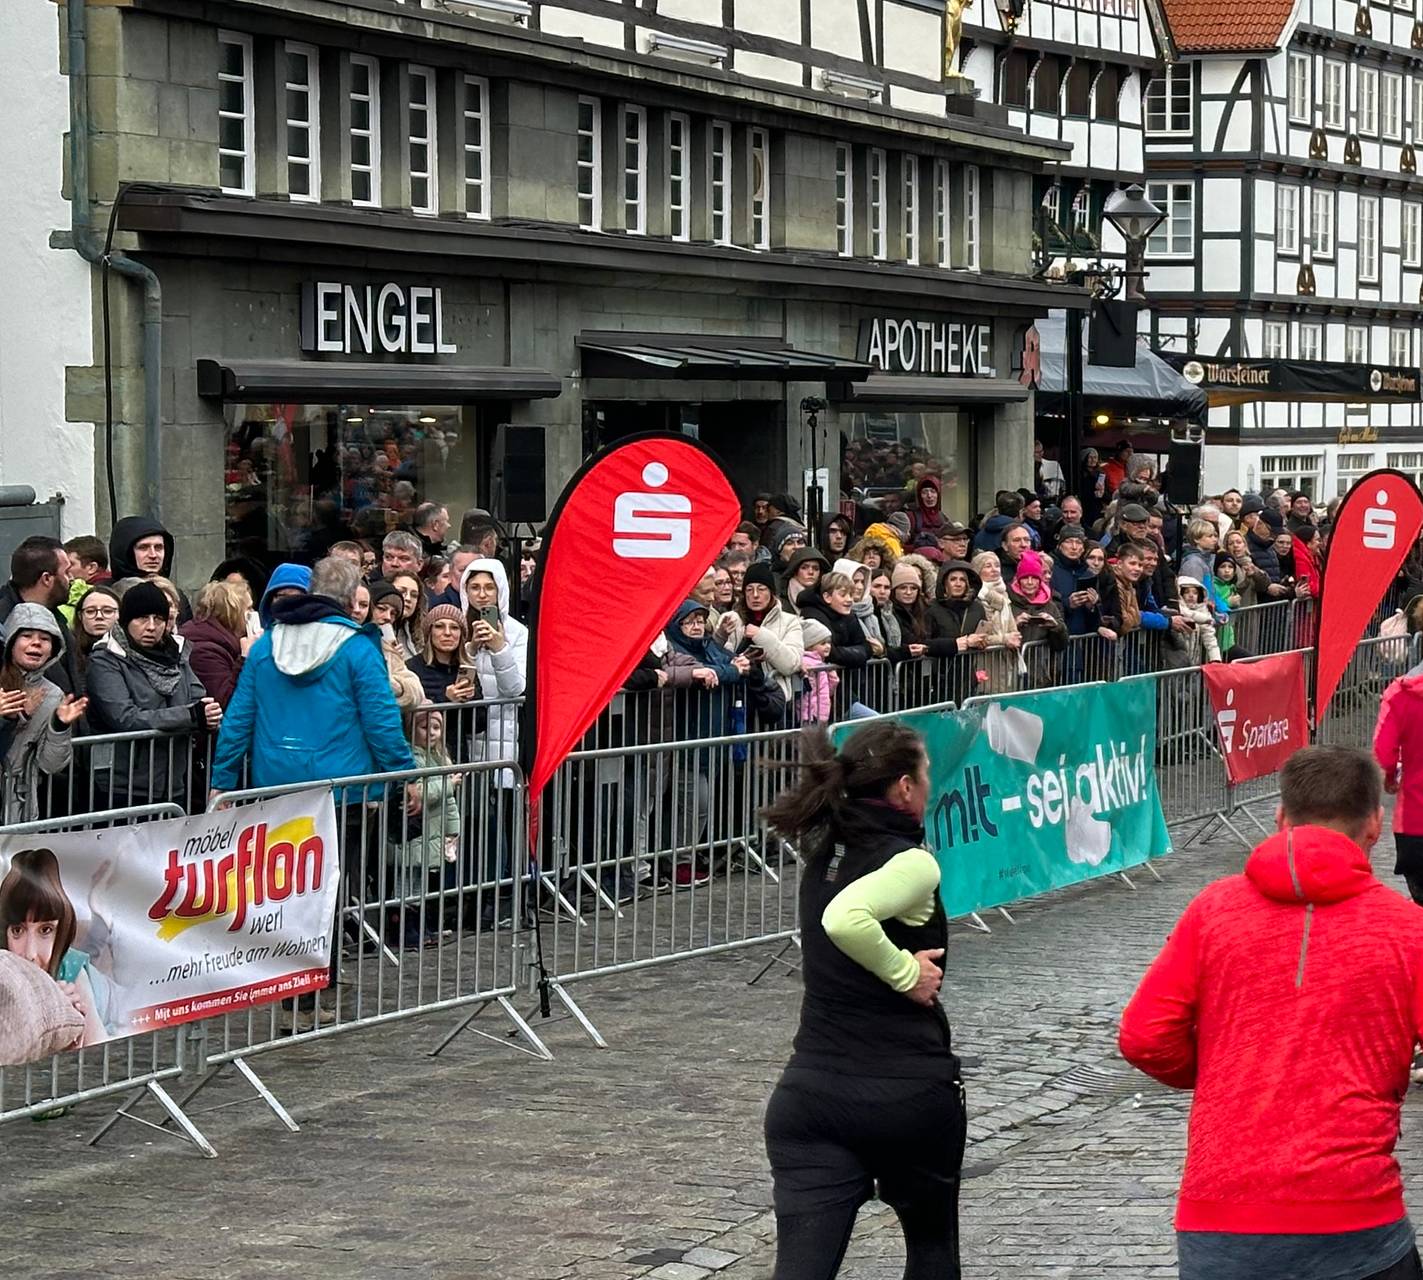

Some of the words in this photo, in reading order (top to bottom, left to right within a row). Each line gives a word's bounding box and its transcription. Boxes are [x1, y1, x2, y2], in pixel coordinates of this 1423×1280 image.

[317, 282, 457, 354] ENGEL
[868, 319, 991, 374] APOTHEKE
[1207, 363, 1270, 385] Warsteiner
[1239, 714, 1289, 757] Sparkase
[1027, 754, 1070, 828] sei
[1076, 734, 1147, 813] aktiv!
[184, 821, 237, 857] möbel
[148, 822, 324, 933] turflon
[250, 906, 283, 935] werl
[205, 949, 243, 974] Freude
[245, 946, 269, 963] am
[155, 1007, 170, 1022] Mit
[172, 1004, 190, 1016] uns
[191, 996, 232, 1013] kommen
[234, 991, 248, 1003] Sie
[250, 985, 276, 1001] immer
[278, 981, 292, 993] ans
